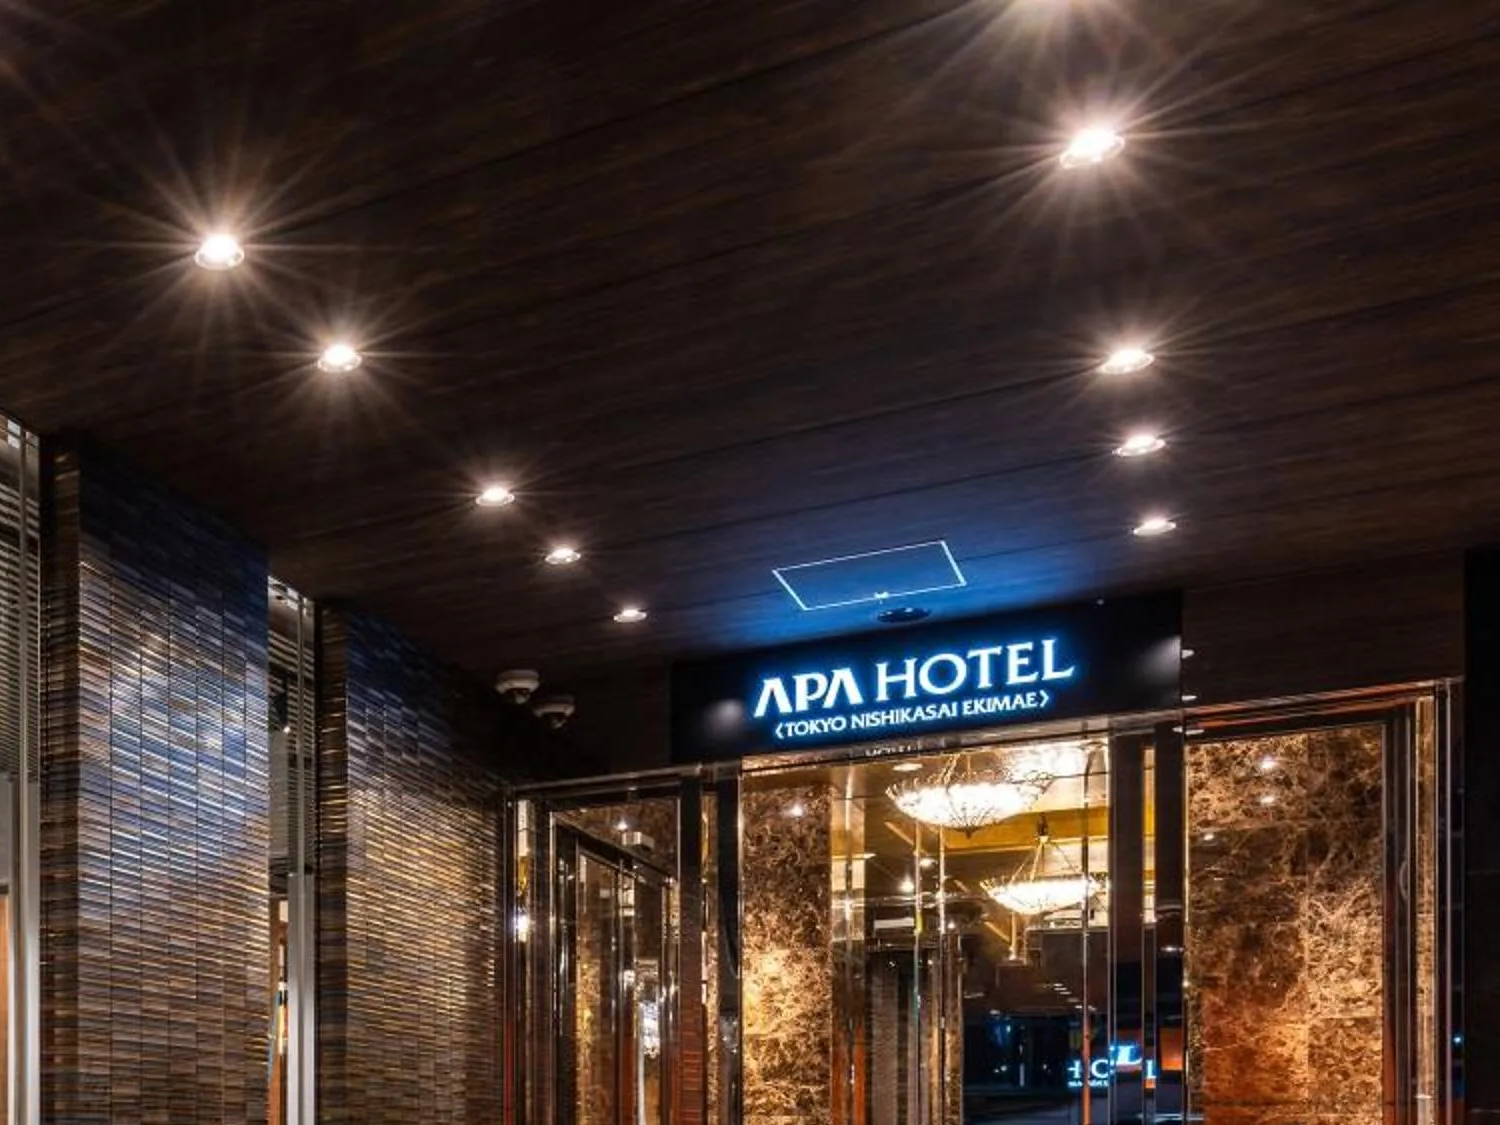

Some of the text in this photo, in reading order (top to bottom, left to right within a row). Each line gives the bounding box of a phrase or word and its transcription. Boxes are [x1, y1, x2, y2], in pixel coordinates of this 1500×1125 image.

[754, 639, 1075, 717] APA HOTEL
[851, 705, 957, 730] NISHIKASAI
